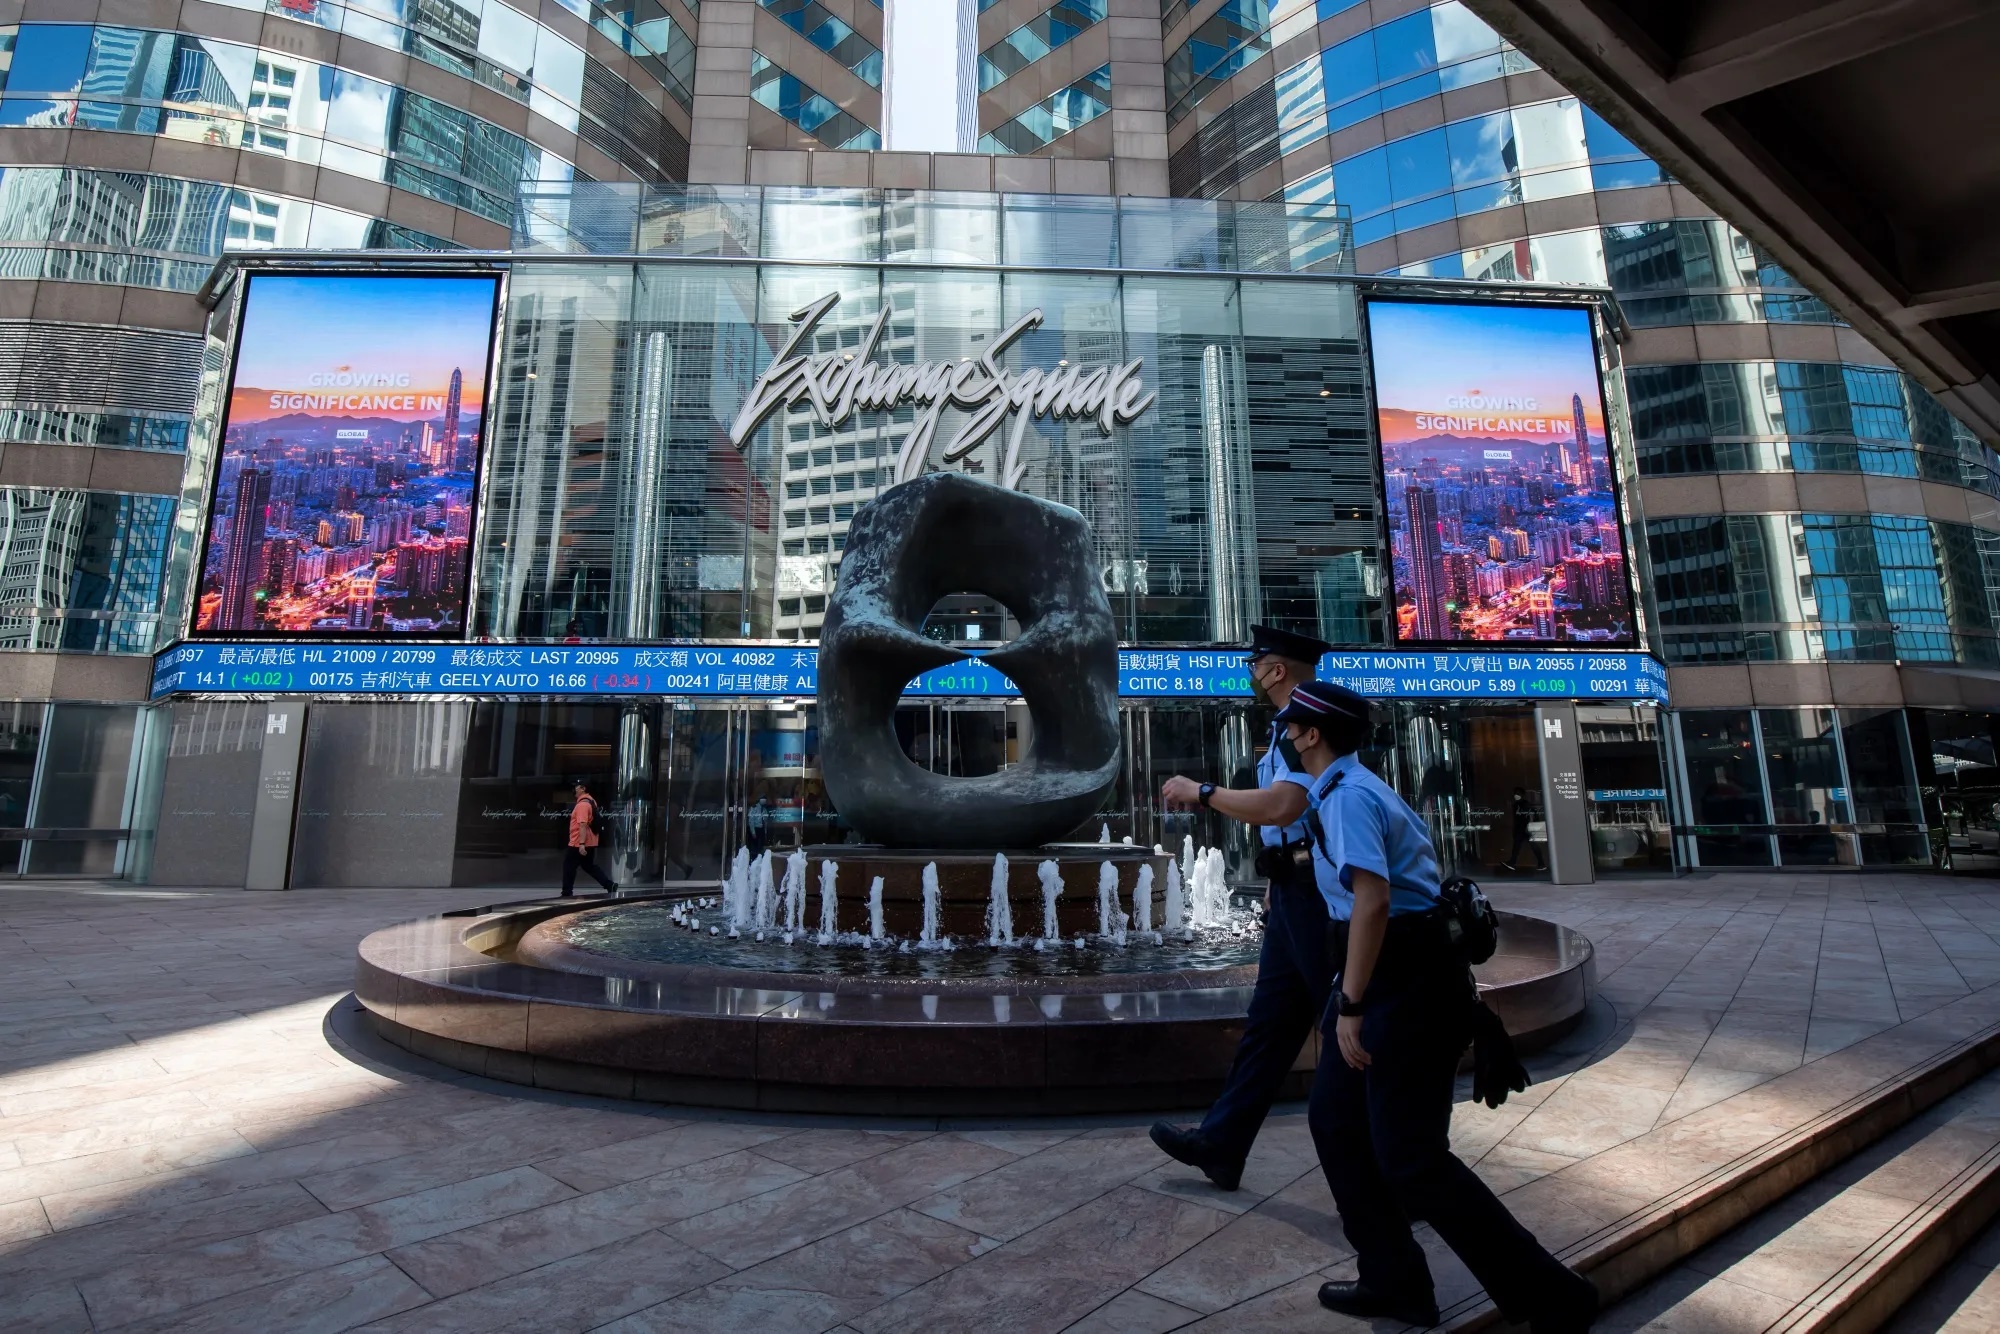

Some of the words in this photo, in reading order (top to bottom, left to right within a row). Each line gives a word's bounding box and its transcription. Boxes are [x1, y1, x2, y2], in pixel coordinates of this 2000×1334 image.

[308, 371, 411, 388] GROWING
[729, 290, 977, 485] Exchange
[943, 306, 1157, 490] Square
[269, 393, 415, 411] SIGNIFICANCE
[419, 395, 443, 411] IN
[1446, 394, 1538, 411] GROWING
[1415, 414, 1547, 433] SIGNIFICANCE
[1551, 419, 1571, 434] IN
[218, 647, 296, 666] 最高/最低
[303, 650, 327, 663] H/L
[332, 650, 377, 663] 21009
[392, 650, 436, 664] 20799
[451, 649, 523, 667] 最後成交
[530, 651, 571, 665] LAST
[575, 651, 620, 665] 20995
[634, 650, 689, 669] 成交額
[695, 652, 726, 666] VOL
[732, 652, 776, 666] 40982
[1189, 655, 1213, 668] HSI
[1332, 656, 1371, 669] NEXT
[1374, 656, 1426, 670] MONTH
[1433, 655, 1503, 673] 買入/賣出
[1508, 657, 1532, 670] B/A
[1536, 657, 1575, 671] 20955
[1588, 658, 1627, 671] 20958
[196, 671, 224, 685] 14.1
[243, 673, 281, 686] +0.02
[309, 672, 354, 686] 00175
[360, 671, 433, 689] 吉利汽車
[440, 673, 491, 687] GEELY
[495, 674, 539, 688] AUTO
[548, 674, 587, 688] 16.66
[604, 675, 639, 688] -0.34
[667, 675, 709, 688] 00241
[717, 673, 789, 692] 阿里健康
[938, 676, 975, 690] +0.11
[1128, 676, 1168, 691] CITIC
[1174, 677, 1204, 691] 8.18
[1219, 677, 1250, 691] +0.0
[1402, 678, 1427, 692] WH
[1429, 678, 1481, 692] GROUP
[1488, 678, 1516, 692] 5.89
[1530, 679, 1566, 692] +0.09
[1590, 679, 1628, 692] 00291
